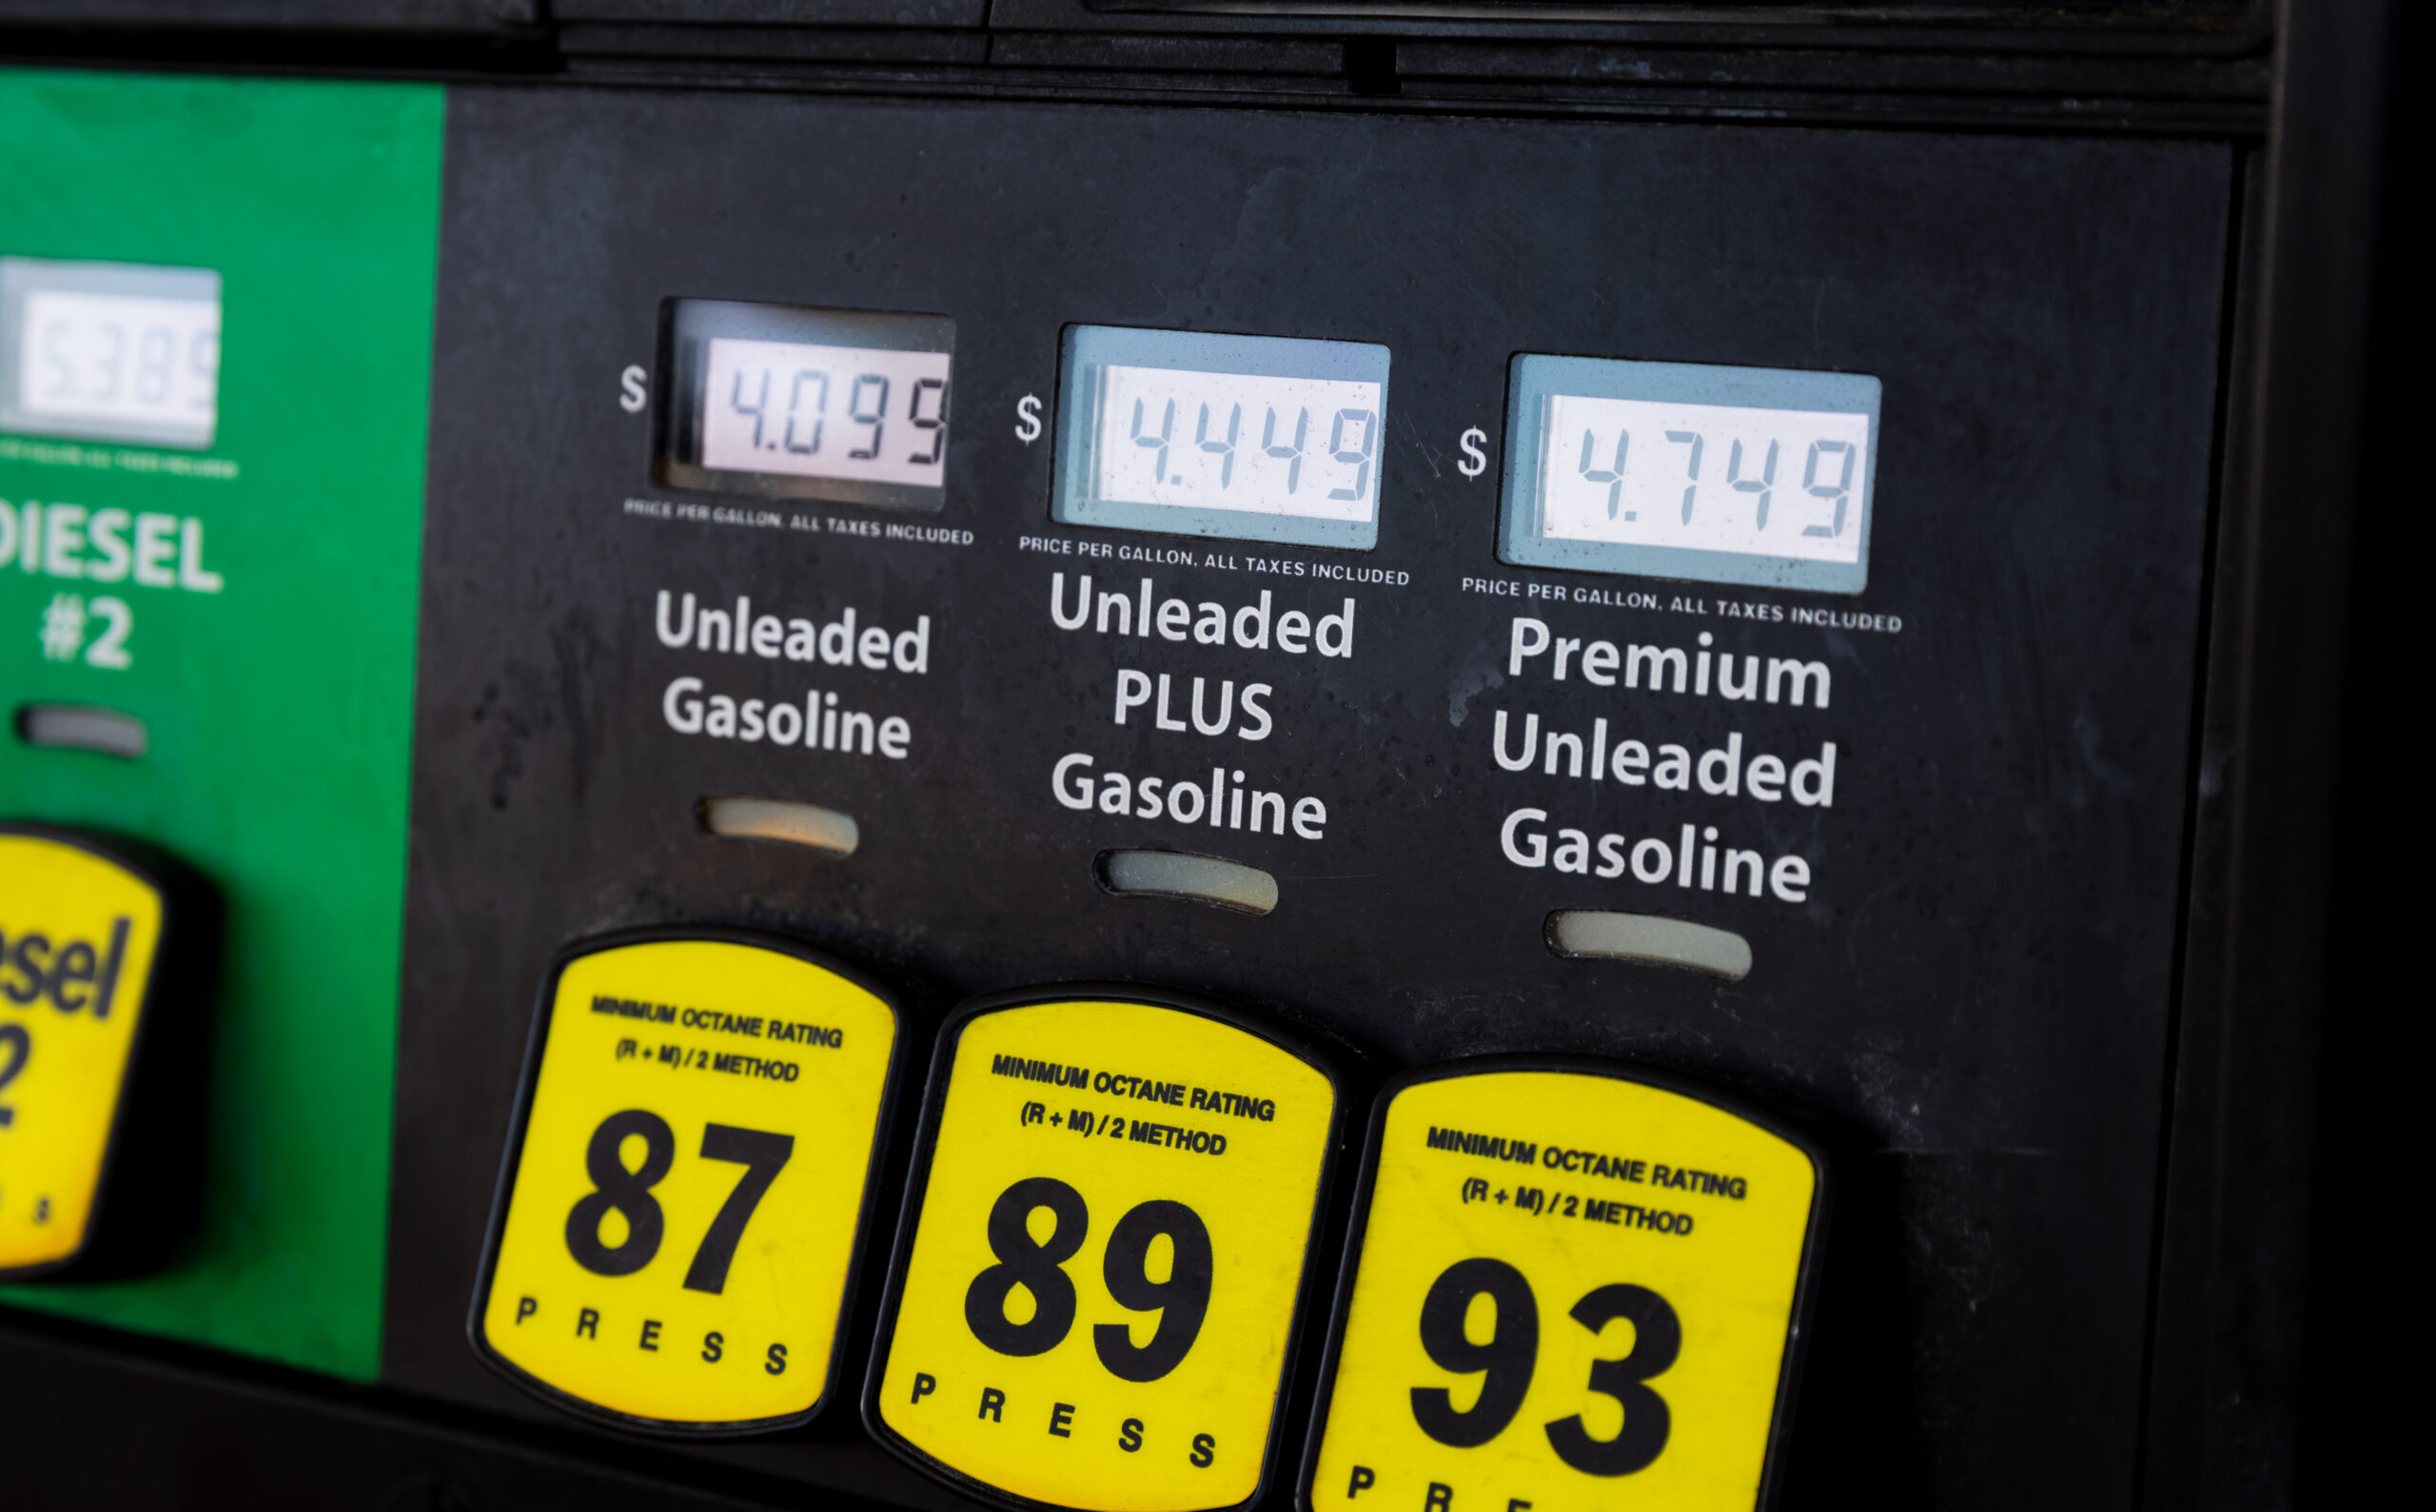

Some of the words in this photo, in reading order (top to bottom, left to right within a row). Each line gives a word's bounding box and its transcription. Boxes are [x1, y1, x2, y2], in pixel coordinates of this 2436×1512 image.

[732, 368, 946, 464] 4.099
[1014, 392, 1043, 446] $
[1130, 396, 1377, 501] 4.449
[1457, 425, 1487, 481] $
[677, 503, 710, 520] PER
[790, 514, 821, 532] ALL
[828, 517, 881, 538] TAXES
[885, 523, 973, 545] INCLUDED
[1579, 427, 1856, 539] 4.749
[1019, 536, 1071, 555] PRICE
[1078, 542, 1112, 559] PER
[1205, 553, 1238, 571] ALL
[1246, 557, 1305, 577] TAXES
[1312, 564, 1409, 586] INCLUDED
[40, 591, 134, 670] #2
[656, 590, 930, 674] Unleaded
[1050, 572, 1355, 658] Unleaded
[1462, 577, 1520, 597] PRICE
[1527, 582, 1566, 601] PER
[1670, 597, 1708, 615] ALL
[1717, 599, 1784, 621] TAXES
[1790, 607, 1902, 634] INCLUDED
[1508, 617, 1831, 709] Premium
[663, 677, 912, 759] Gasoline
[1114, 669, 1273, 741] PLUS
[1052, 753, 1326, 840] Gasoline
[1493, 709, 1837, 807] Unleaded
[1501, 807, 1812, 903] Gasoline
[0, 916, 131, 1018] sel
[590, 994, 676, 1024] MINIMUM
[681, 1009, 762, 1037] OCTANE
[768, 1020, 844, 1049] RATING
[697, 1051, 708, 1070] 2
[713, 1054, 799, 1082] METHOD
[992, 1053, 1090, 1090] MINIMUM
[1093, 1071, 1186, 1107] OCTANE
[1189, 1089, 1275, 1122] RATING
[1110, 1117, 1124, 1138] 2
[1130, 1120, 1227, 1156] METHOD
[1426, 1126, 1537, 1165] MINIMUM
[1542, 1146, 1646, 1183] OCTANE
[1652, 1165, 1747, 1200] RATING
[564, 1109, 796, 1295] 87
[1562, 1195, 1578, 1216] 2
[1584, 1199, 1694, 1236] METHOD
[964, 1176, 1214, 1383] 89
[515, 1296, 788, 1376] PRESS
[1410, 1257, 1682, 1478] 93
[911, 1372, 1216, 1468] PRESS
